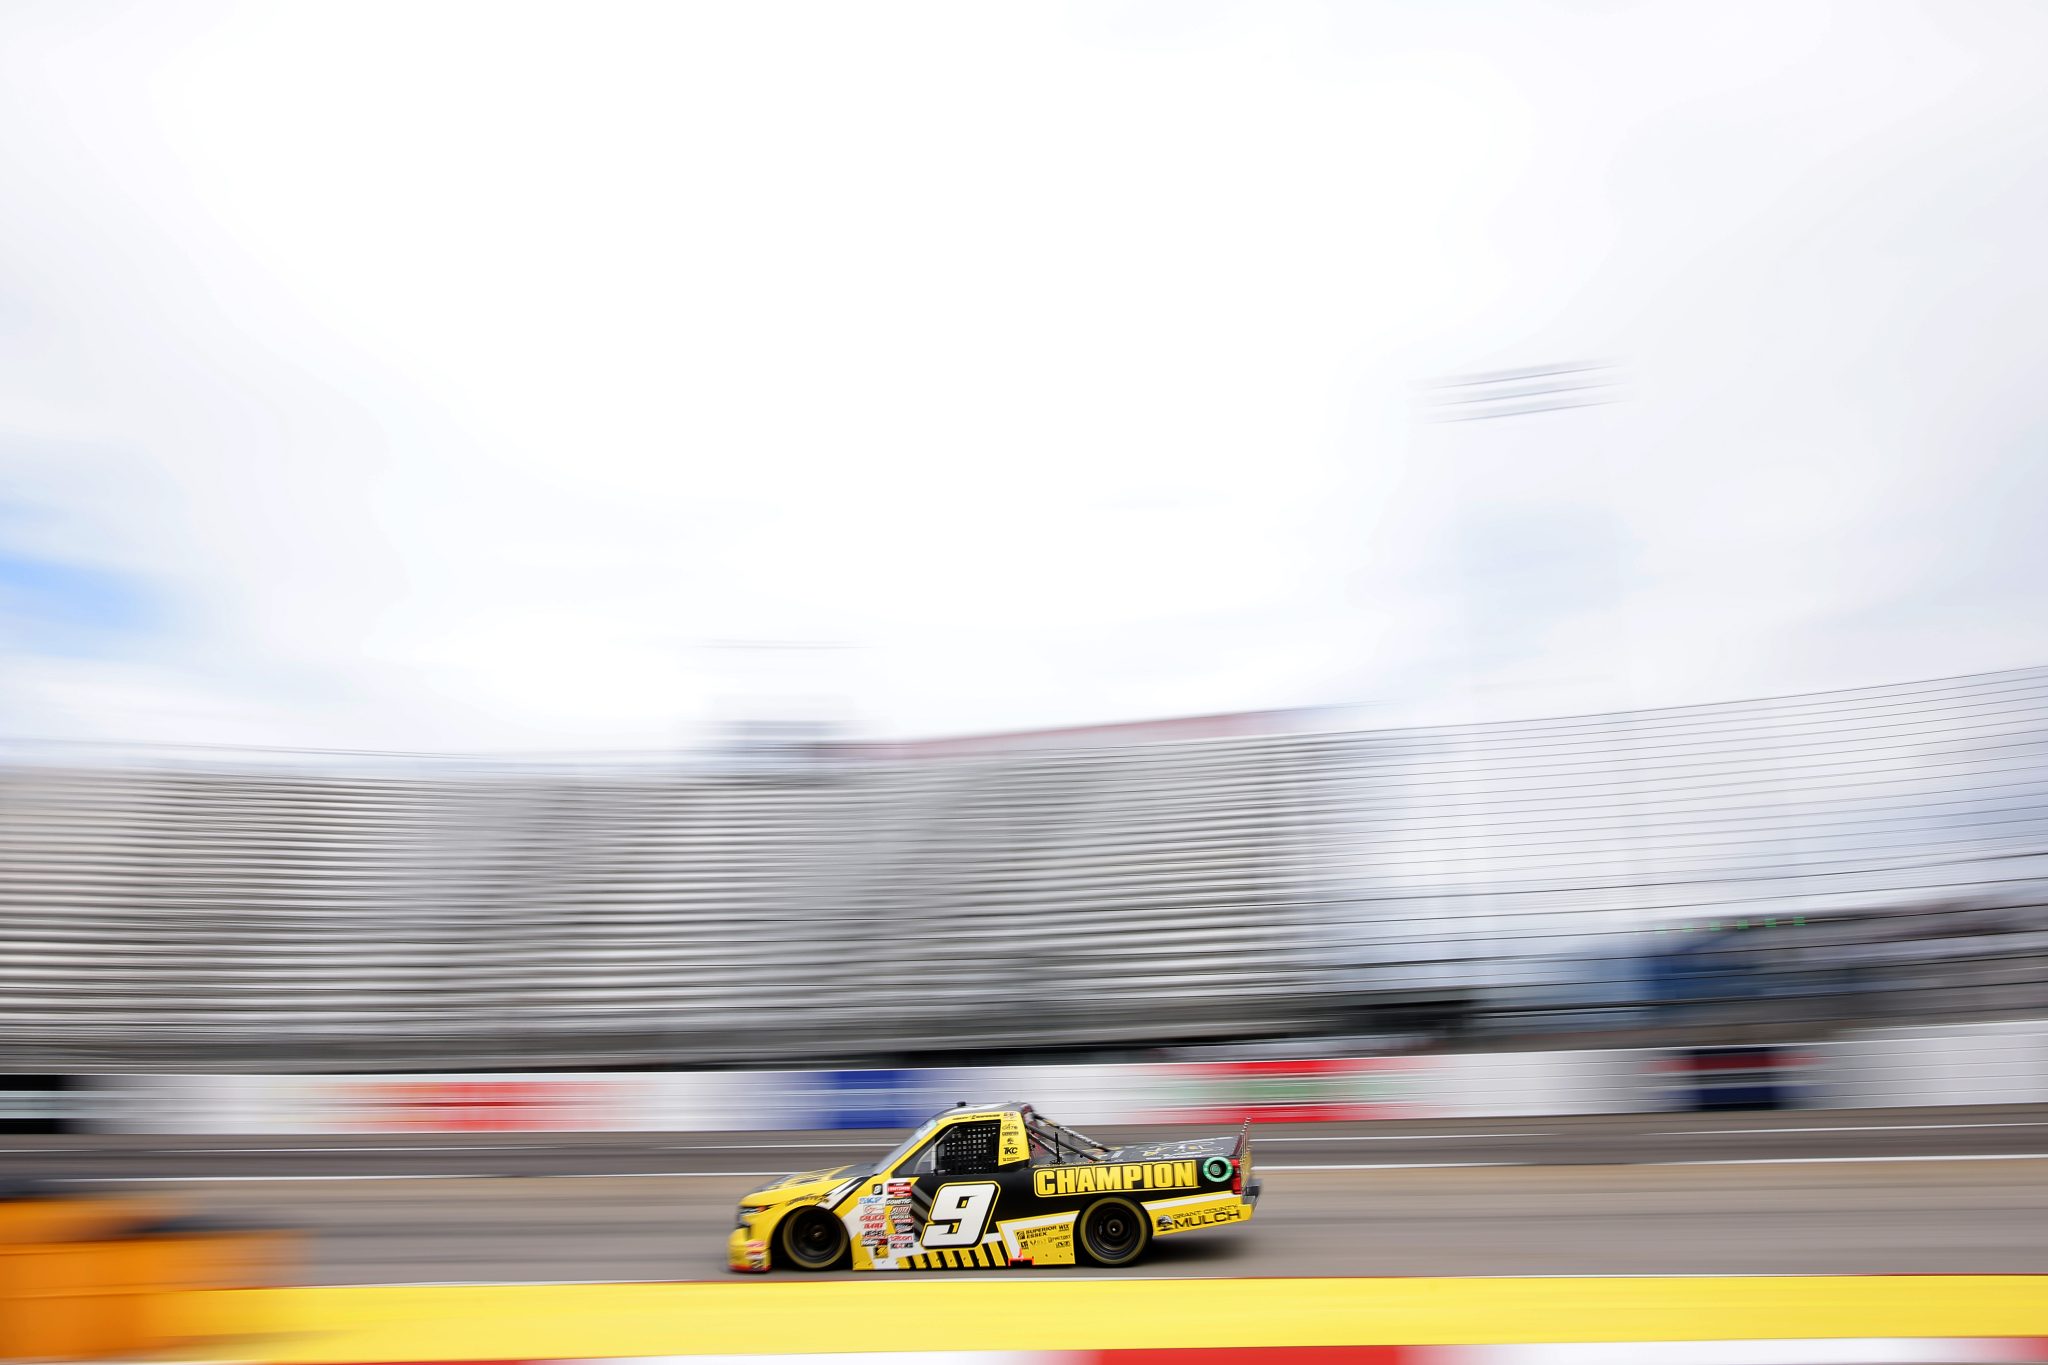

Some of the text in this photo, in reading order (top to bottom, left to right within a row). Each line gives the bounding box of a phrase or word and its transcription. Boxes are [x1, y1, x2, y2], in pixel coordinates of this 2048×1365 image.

[1036, 1162, 1194, 1195] CHAMPION
[922, 1183, 999, 1248] 9
[1172, 1204, 1238, 1219] GRANT COUNTY
[1174, 1210, 1241, 1229] MULCH
[1026, 1225, 1057, 1235] SUPERIOR
[1026, 1231, 1047, 1239] ESSEX
